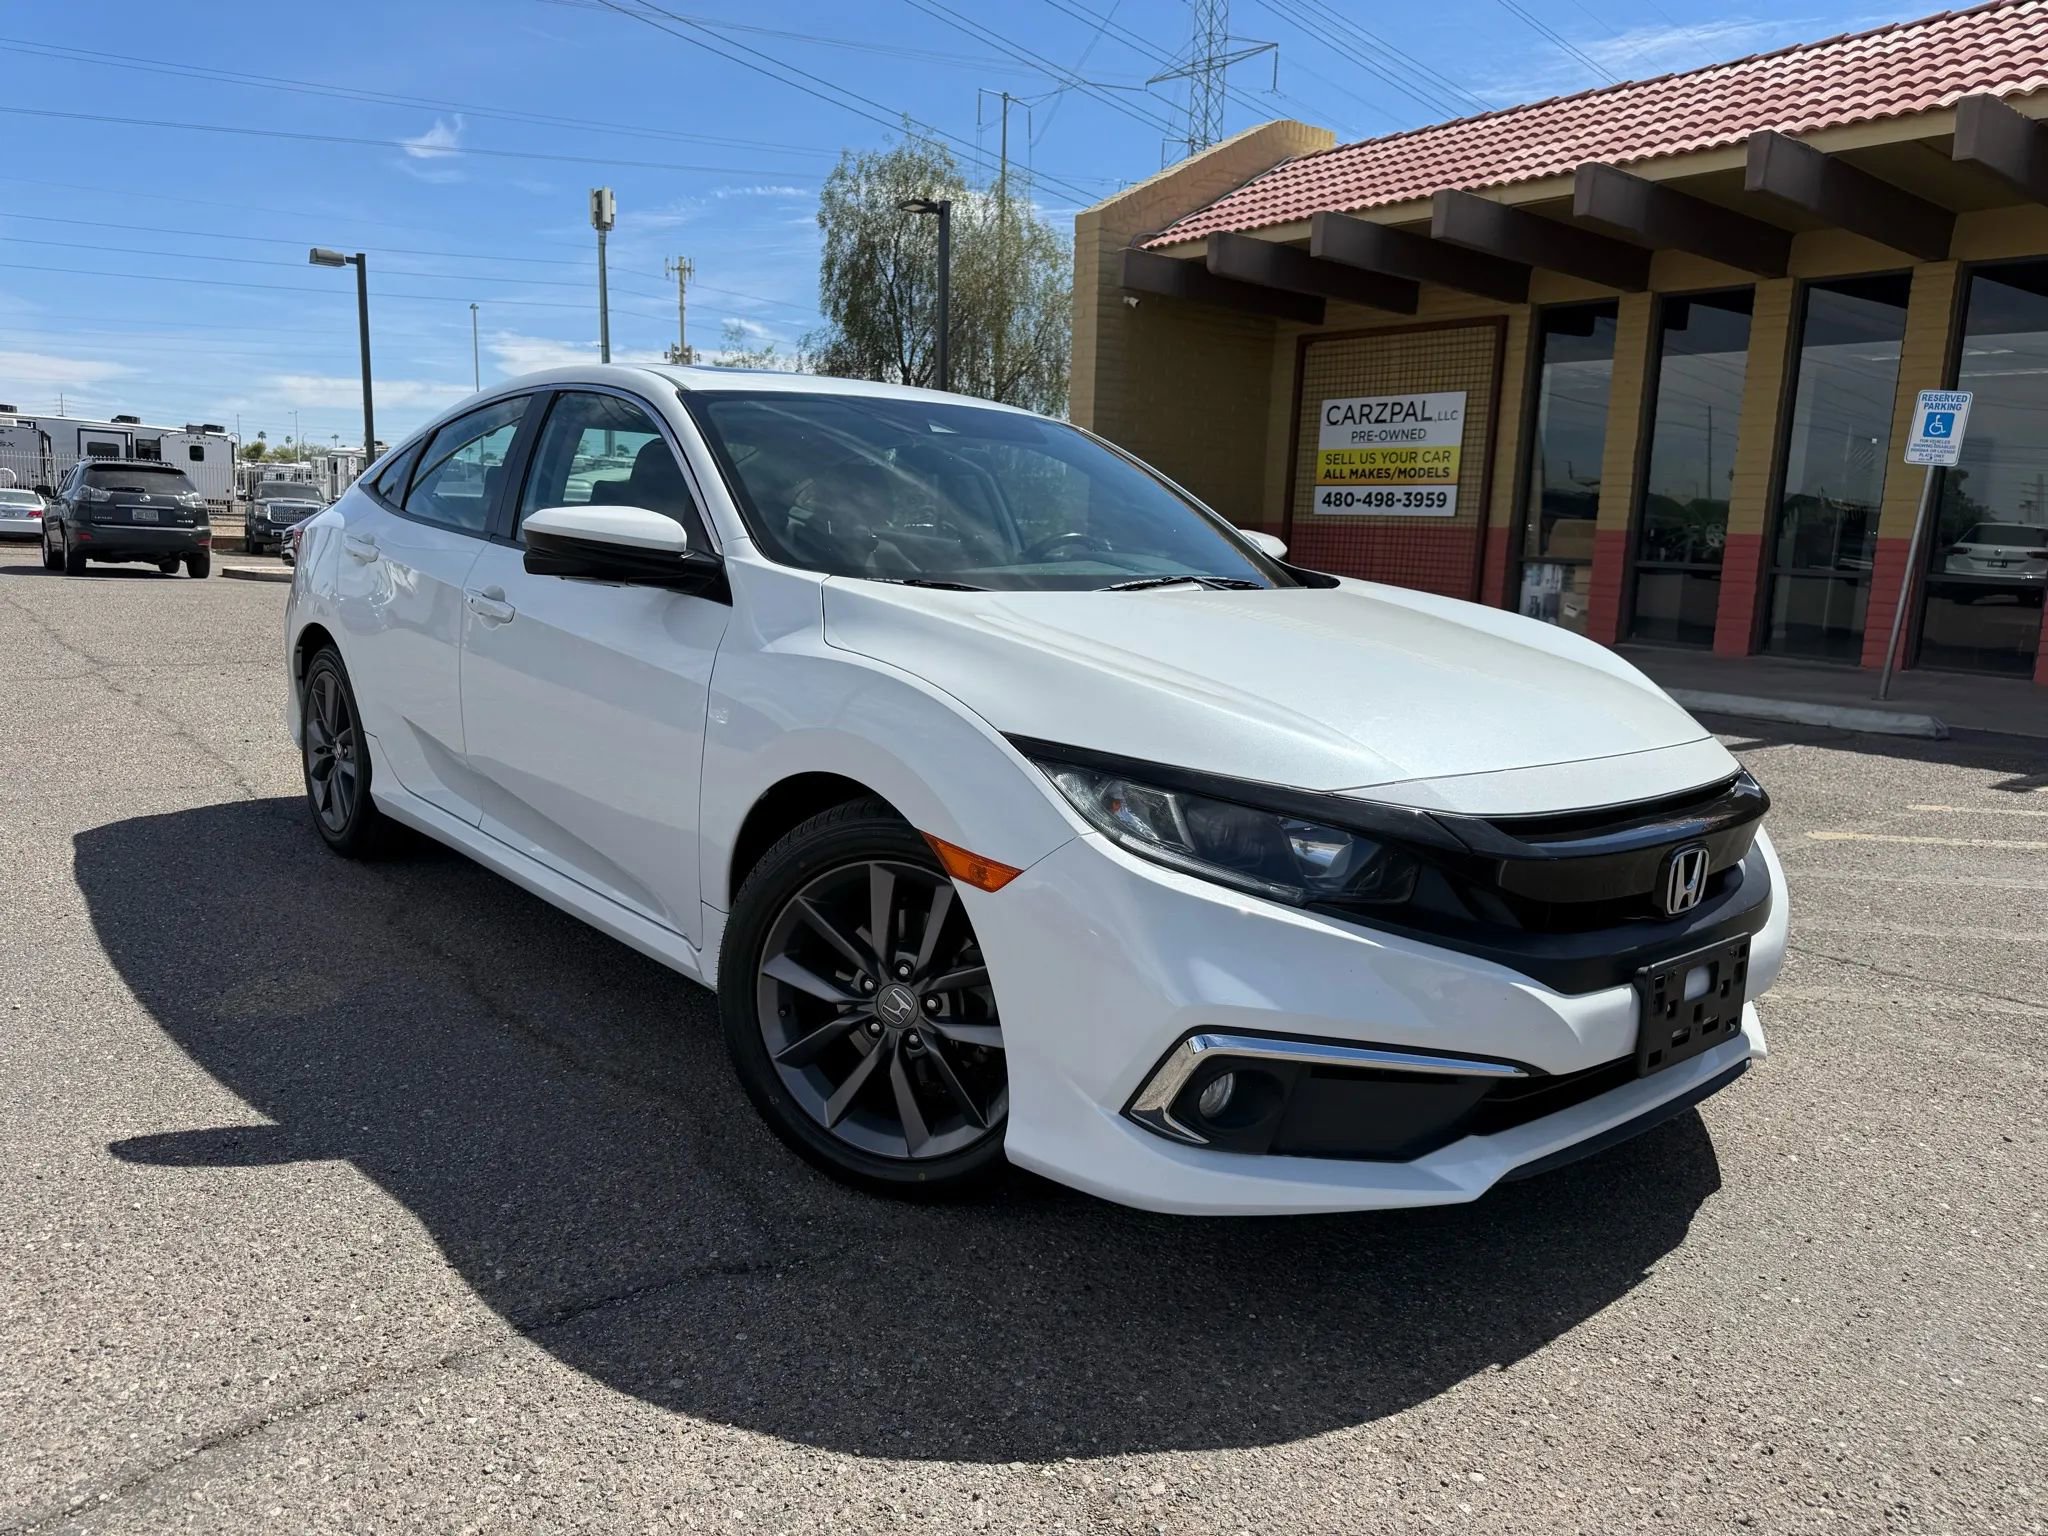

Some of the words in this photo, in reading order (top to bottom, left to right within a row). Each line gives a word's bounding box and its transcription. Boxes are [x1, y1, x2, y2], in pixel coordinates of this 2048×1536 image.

[1921, 393, 1968, 403] RESERVED
[1924, 402, 1962, 411] PARKING
[1351, 428, 1426, 442] PRE-OWNED
[1325, 453, 1356, 466] SELL
[1359, 452, 1376, 465] US
[1380, 451, 1418, 464] YOUR
[1422, 450, 1451, 463] CAR
[1323, 469, 1346, 480] ALL
[1349, 467, 1450, 481] MAKES/MODELS
[1321, 491, 1448, 508] 480-498-3959
